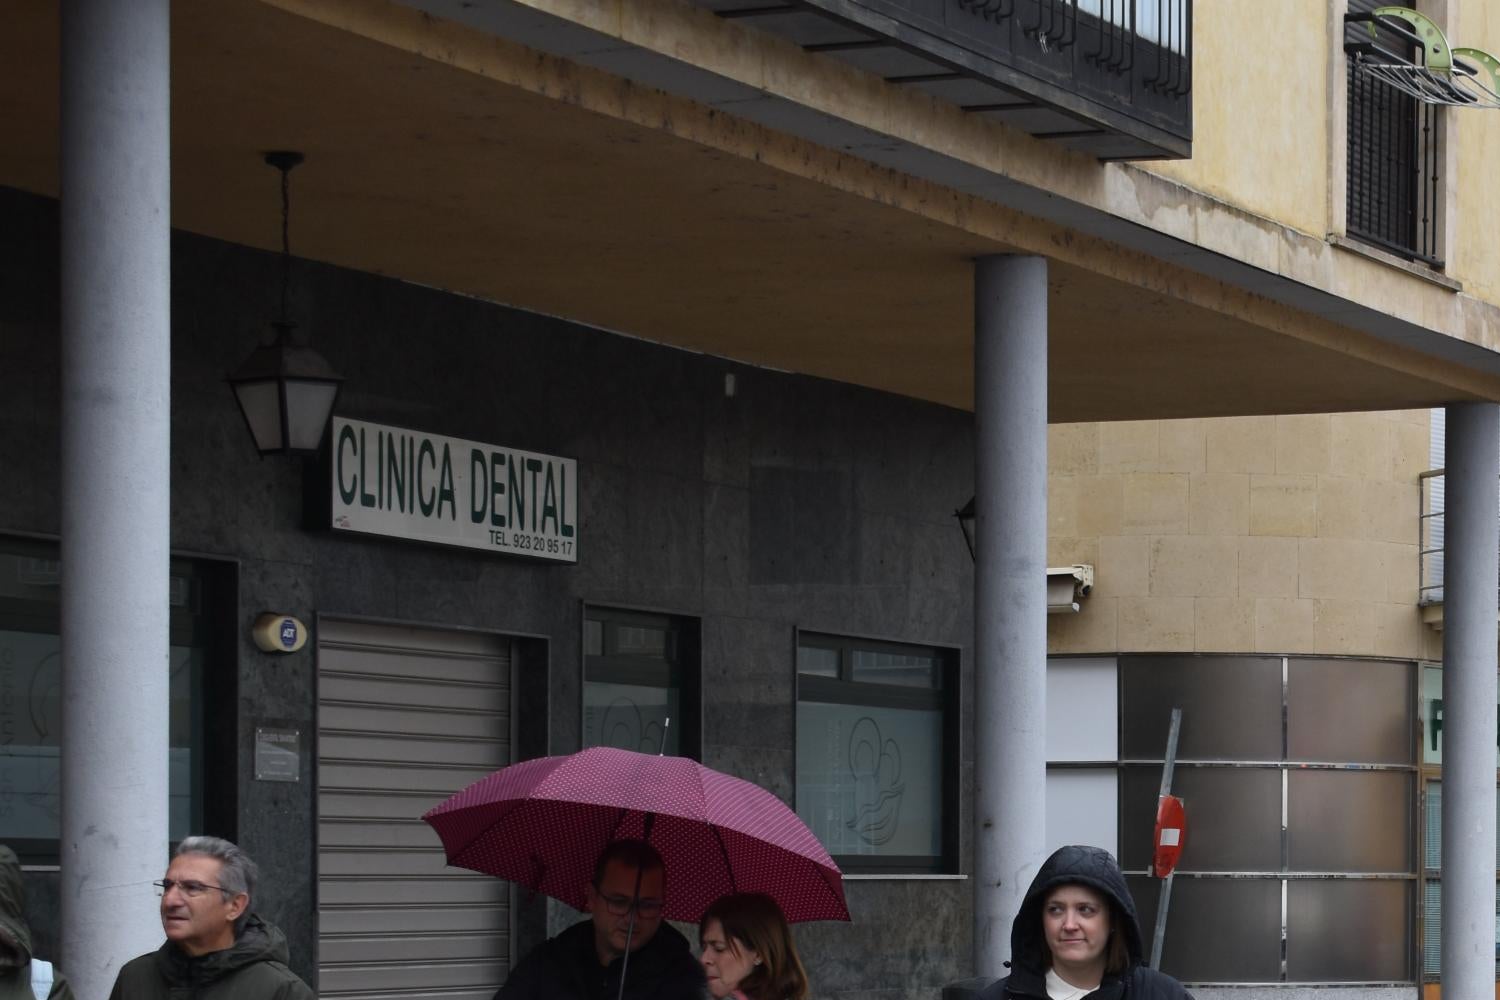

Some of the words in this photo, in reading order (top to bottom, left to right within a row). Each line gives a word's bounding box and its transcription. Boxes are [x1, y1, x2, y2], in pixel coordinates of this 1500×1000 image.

[337, 424, 456, 521] CLINICA
[470, 448, 574, 537] DENTAL
[489, 529, 511, 546] TEL.
[513, 533, 531, 549] 923
[533, 536, 545, 551] 20
[547, 538, 559, 553] 95
[561, 541, 573, 555] 17
